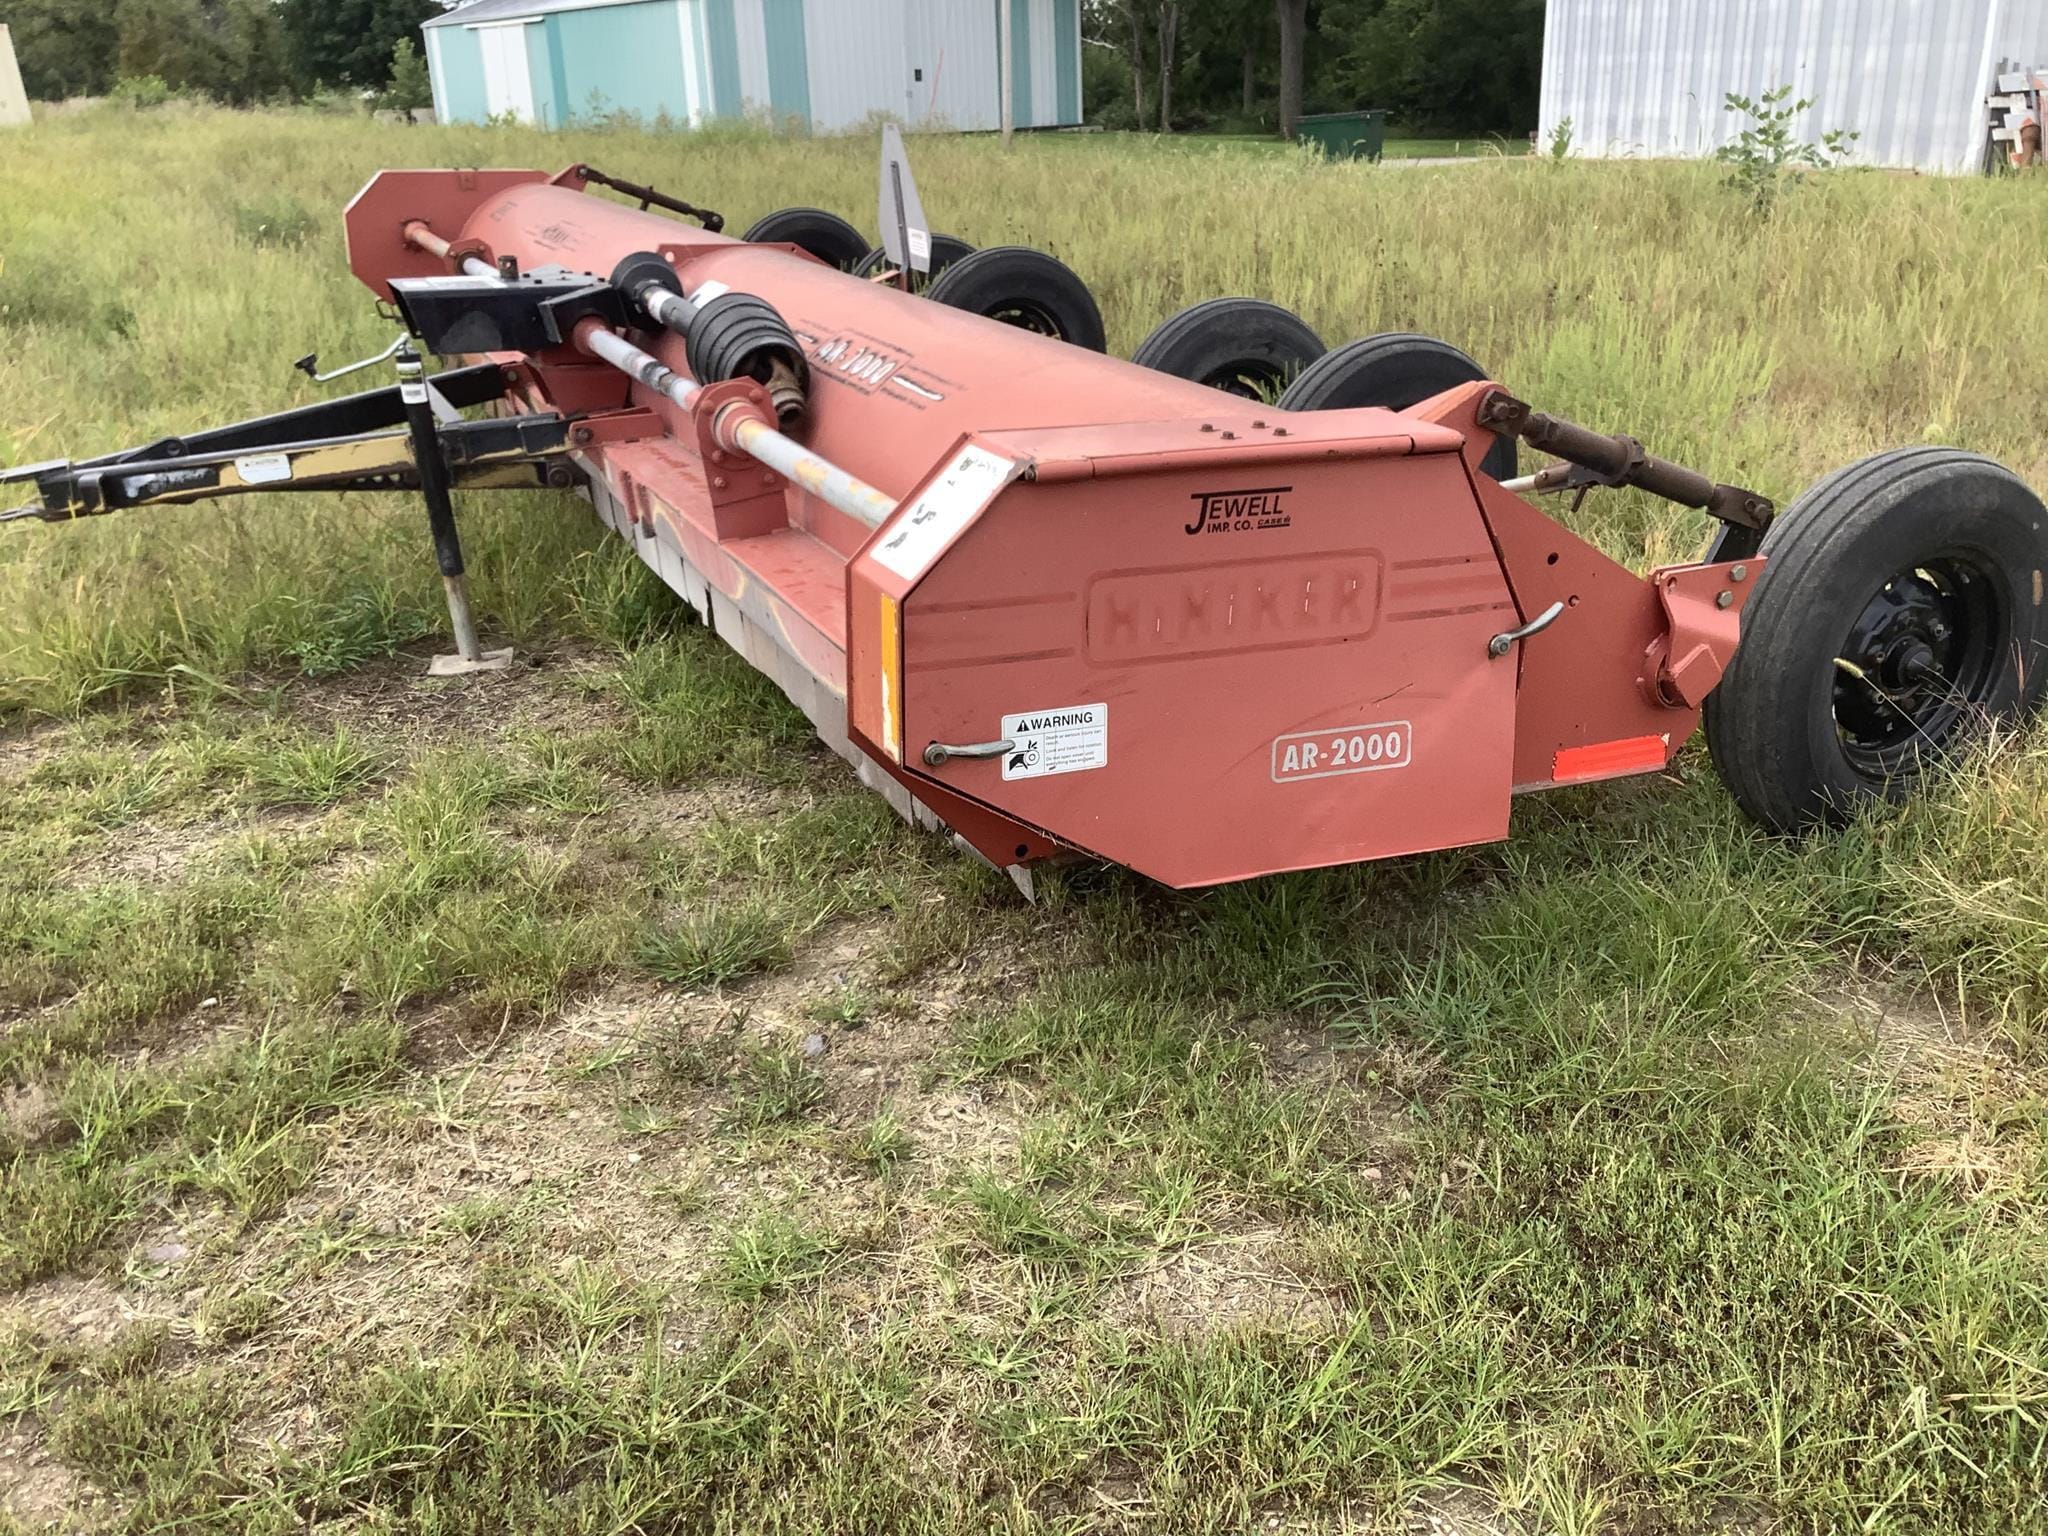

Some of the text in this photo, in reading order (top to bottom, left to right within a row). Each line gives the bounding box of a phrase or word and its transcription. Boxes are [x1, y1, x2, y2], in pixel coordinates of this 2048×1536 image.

[1185, 486, 1293, 536] JEWELL
[1207, 521, 1230, 533] IMP.
[1234, 519, 1254, 531] CO.
[1257, 517, 1282, 526] CASE
[1031, 711, 1093, 730] WARNING
[1281, 731, 1402, 773] AR-2000
